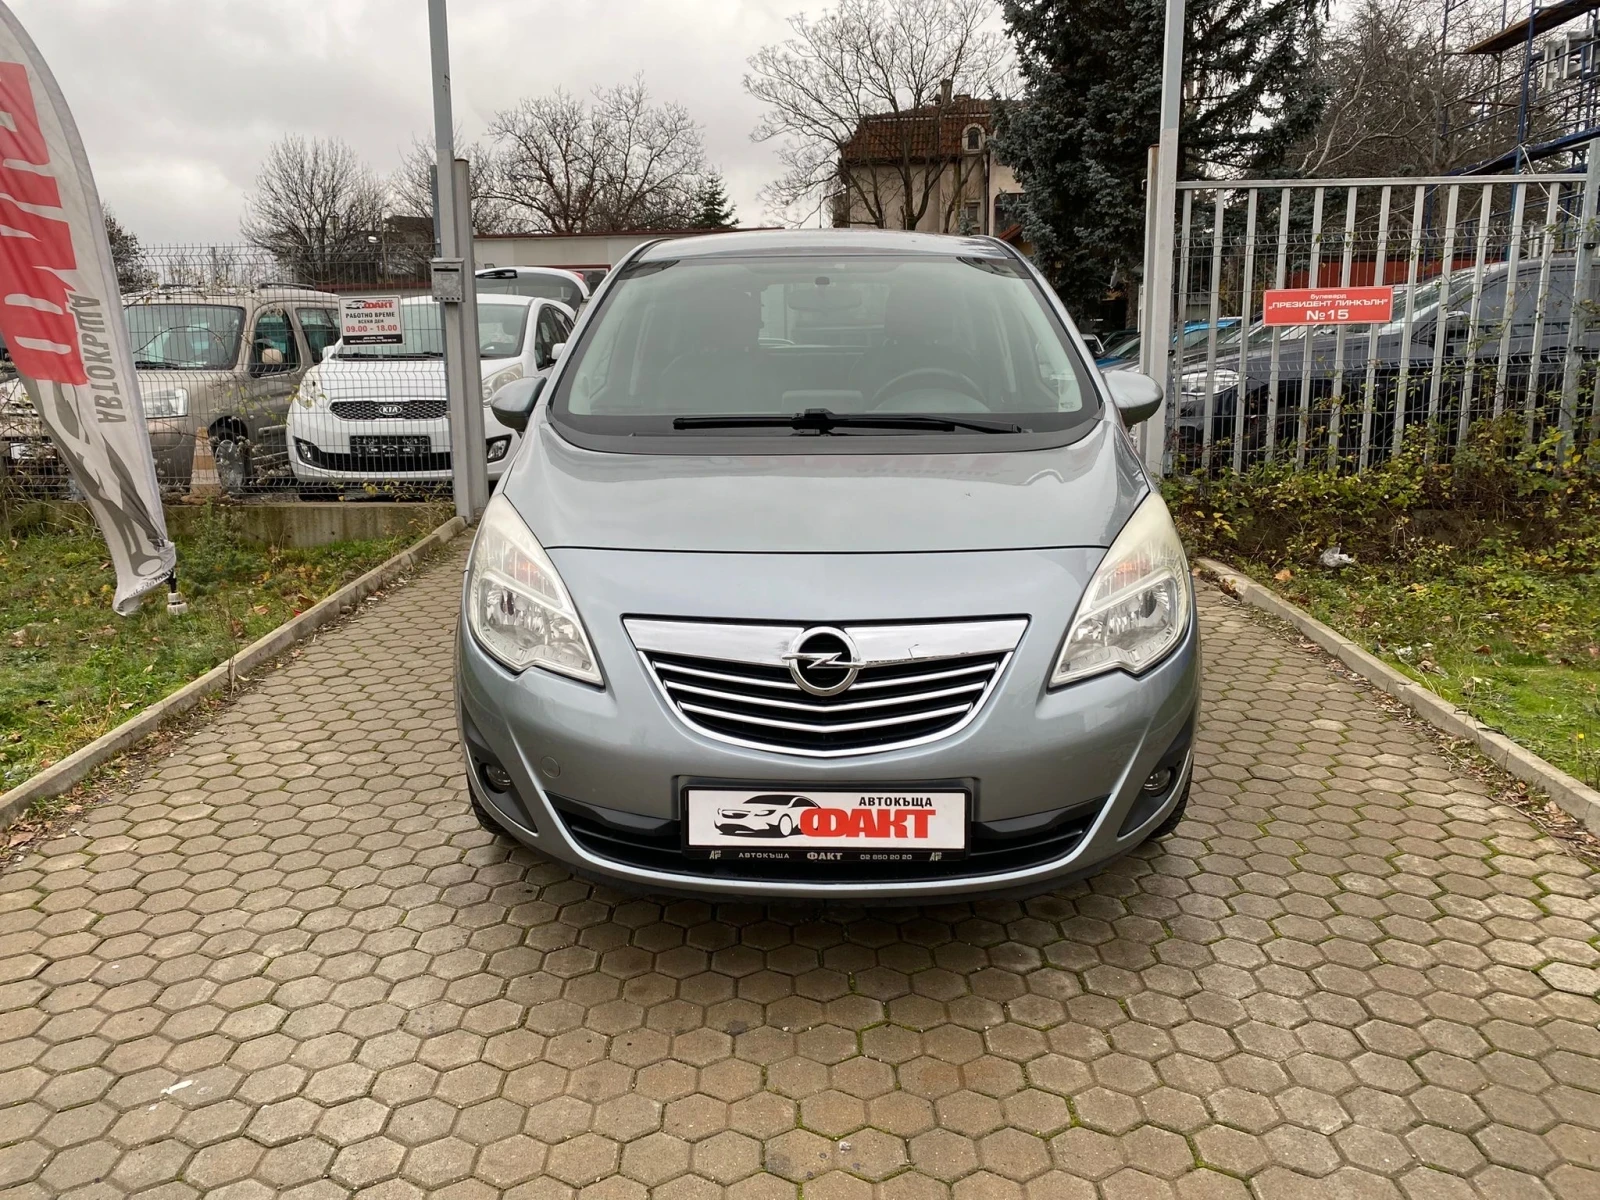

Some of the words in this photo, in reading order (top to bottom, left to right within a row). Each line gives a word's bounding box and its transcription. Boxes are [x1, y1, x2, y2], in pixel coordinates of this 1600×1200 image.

[859, 796, 933, 807] АВТОКЪЩА
[799, 808, 936, 838] ФАКТ
[806, 851, 843, 861] ФАКТ
